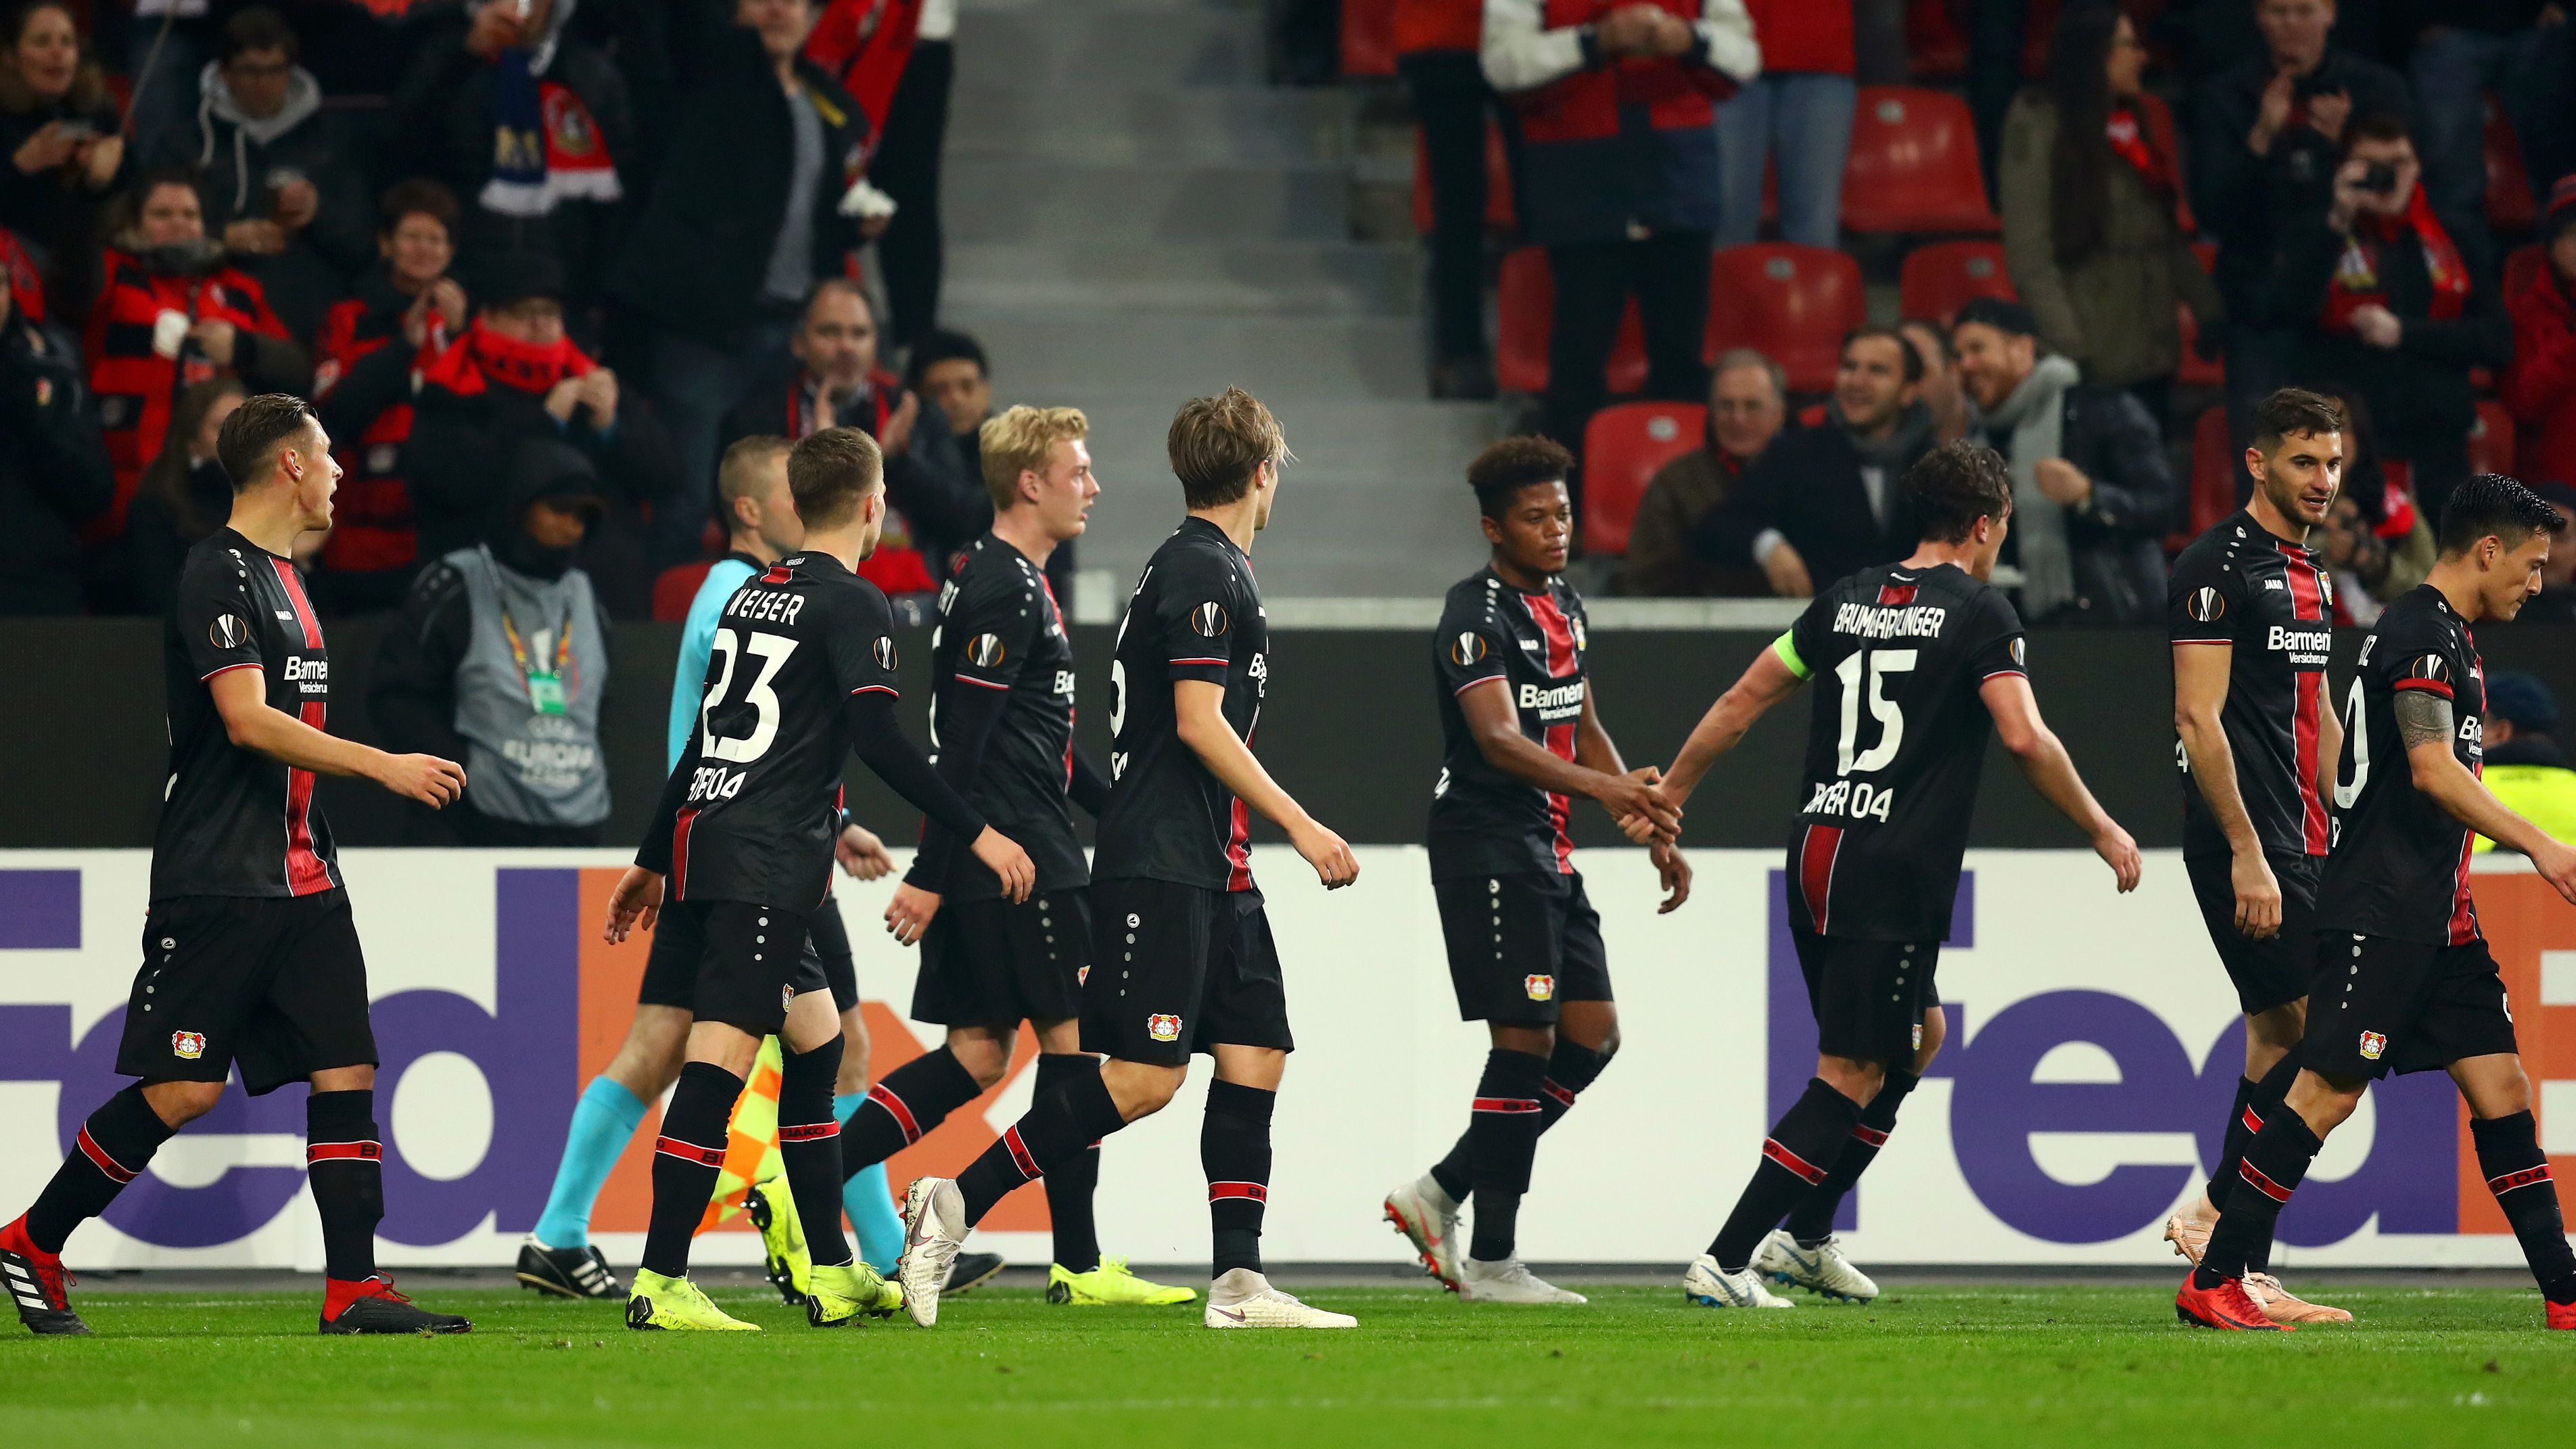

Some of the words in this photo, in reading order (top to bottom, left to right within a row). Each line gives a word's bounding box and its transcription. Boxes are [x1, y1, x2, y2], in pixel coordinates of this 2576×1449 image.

[2264, 579, 2283, 590] JAKO
[701, 628, 799, 764] 23
[1835, 649, 1918, 777] 15
[1850, 783, 1894, 823] 04
